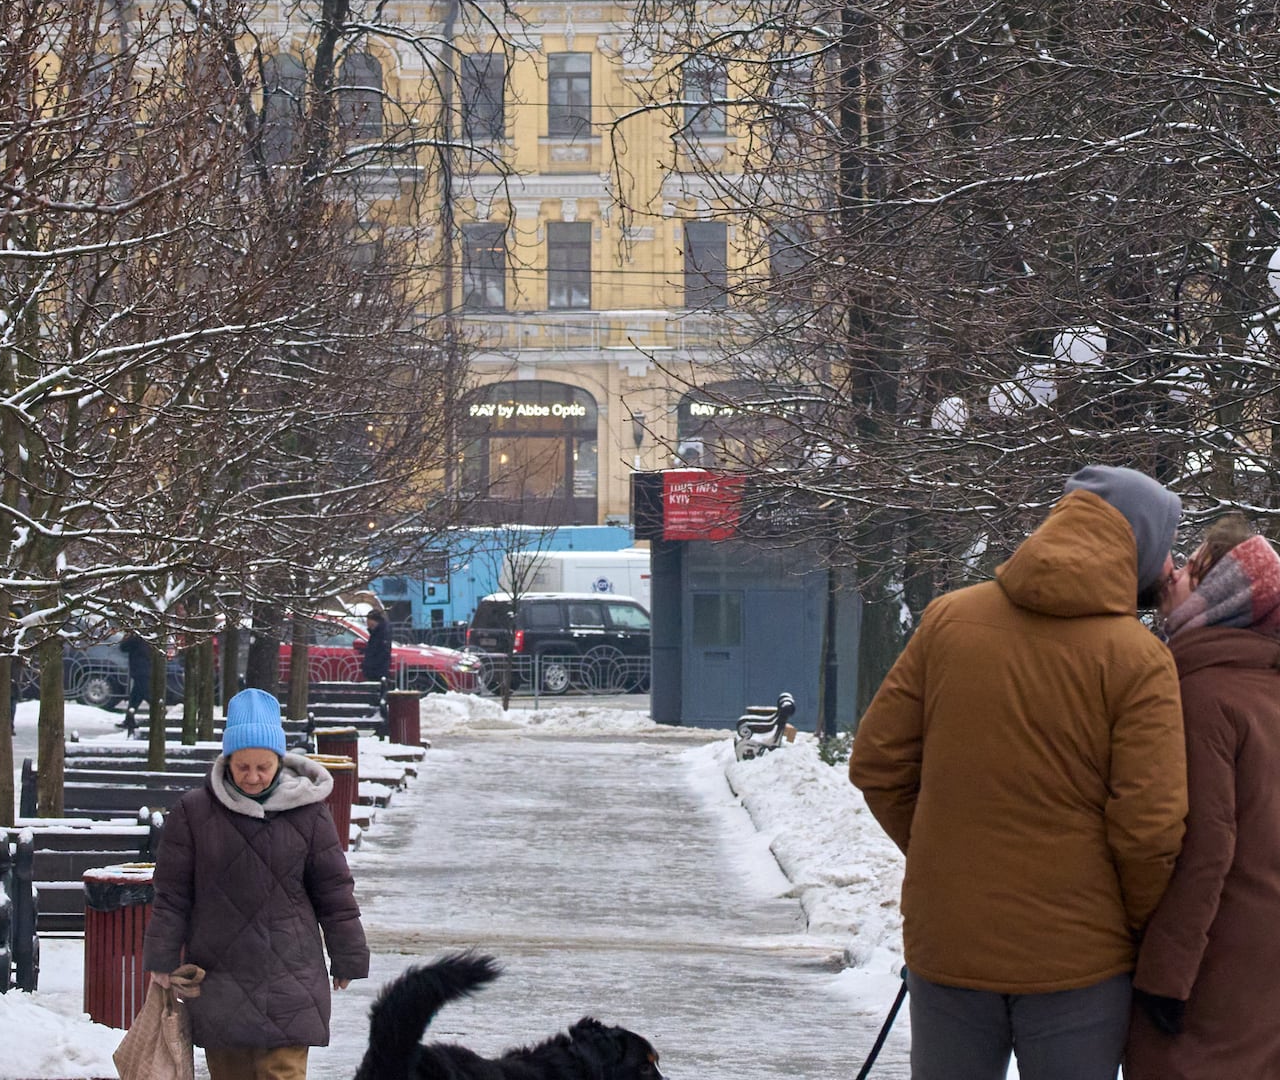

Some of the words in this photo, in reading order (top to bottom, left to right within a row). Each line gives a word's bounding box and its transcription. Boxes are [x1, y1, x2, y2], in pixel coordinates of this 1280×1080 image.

[498, 404, 513, 418] by
[516, 404, 549, 417] Abbe
[552, 403, 586, 418] Optic
[690, 403, 716, 416] RAY
[669, 494, 690, 504] KYIV
